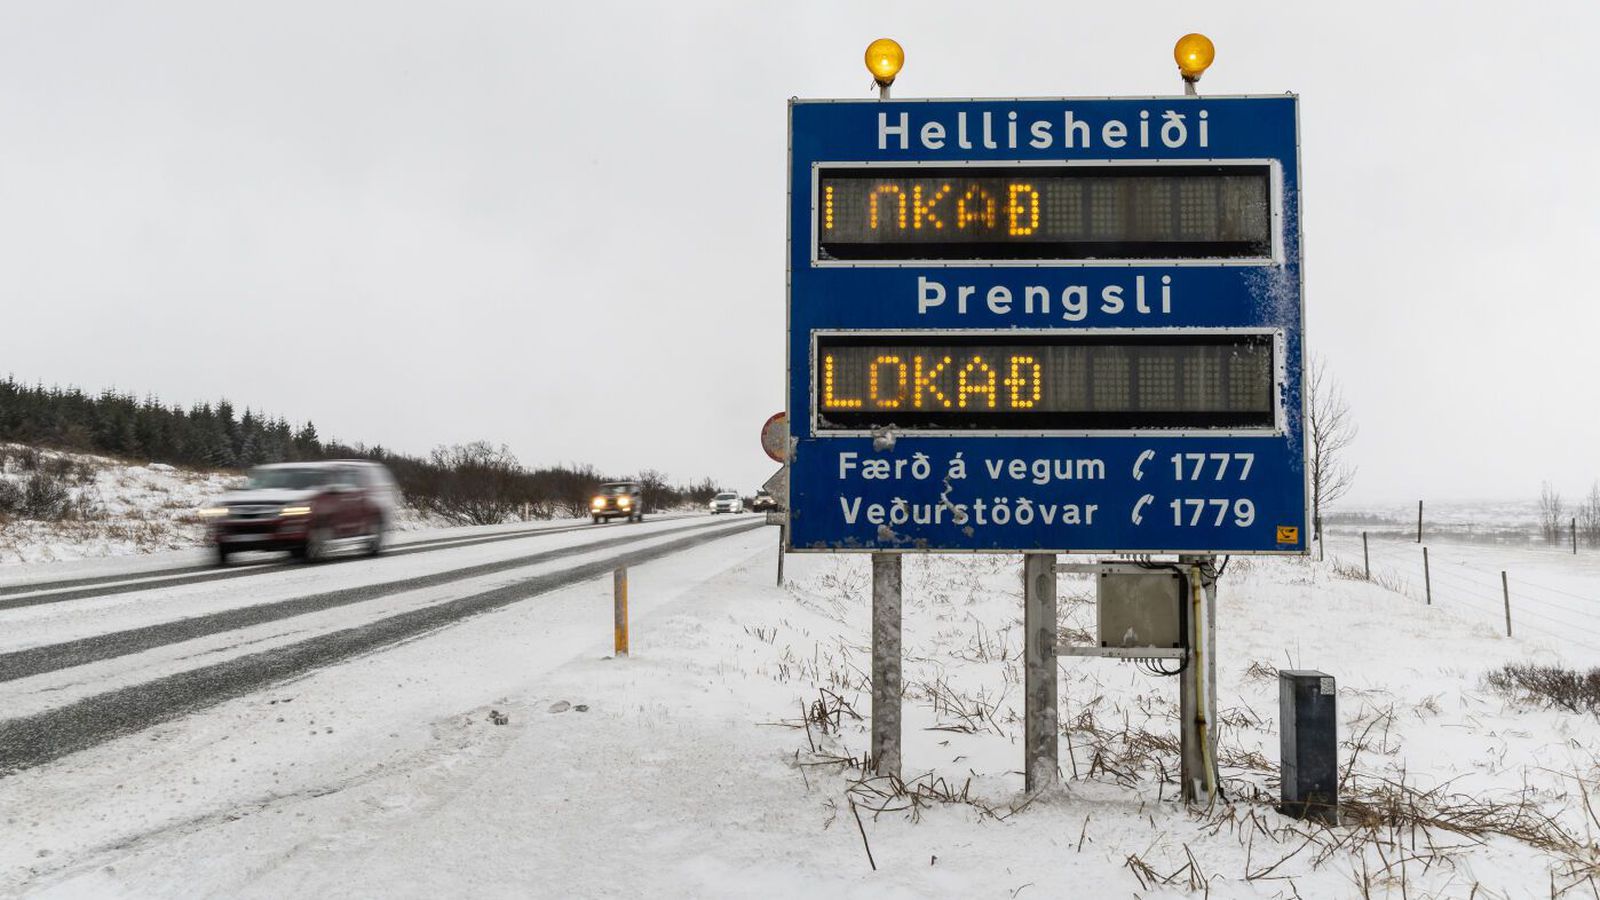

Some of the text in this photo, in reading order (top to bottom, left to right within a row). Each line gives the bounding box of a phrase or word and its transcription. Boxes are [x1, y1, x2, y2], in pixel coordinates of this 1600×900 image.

[878, 110, 1209, 149] Hellisheiði
[918, 275, 1172, 321] Þrengsli
[824, 355, 1041, 408] LOKAÐ
[839, 452, 1255, 485] Færð á vegum 1777
[840, 496, 1256, 527] Veðurstöðvar 1779
